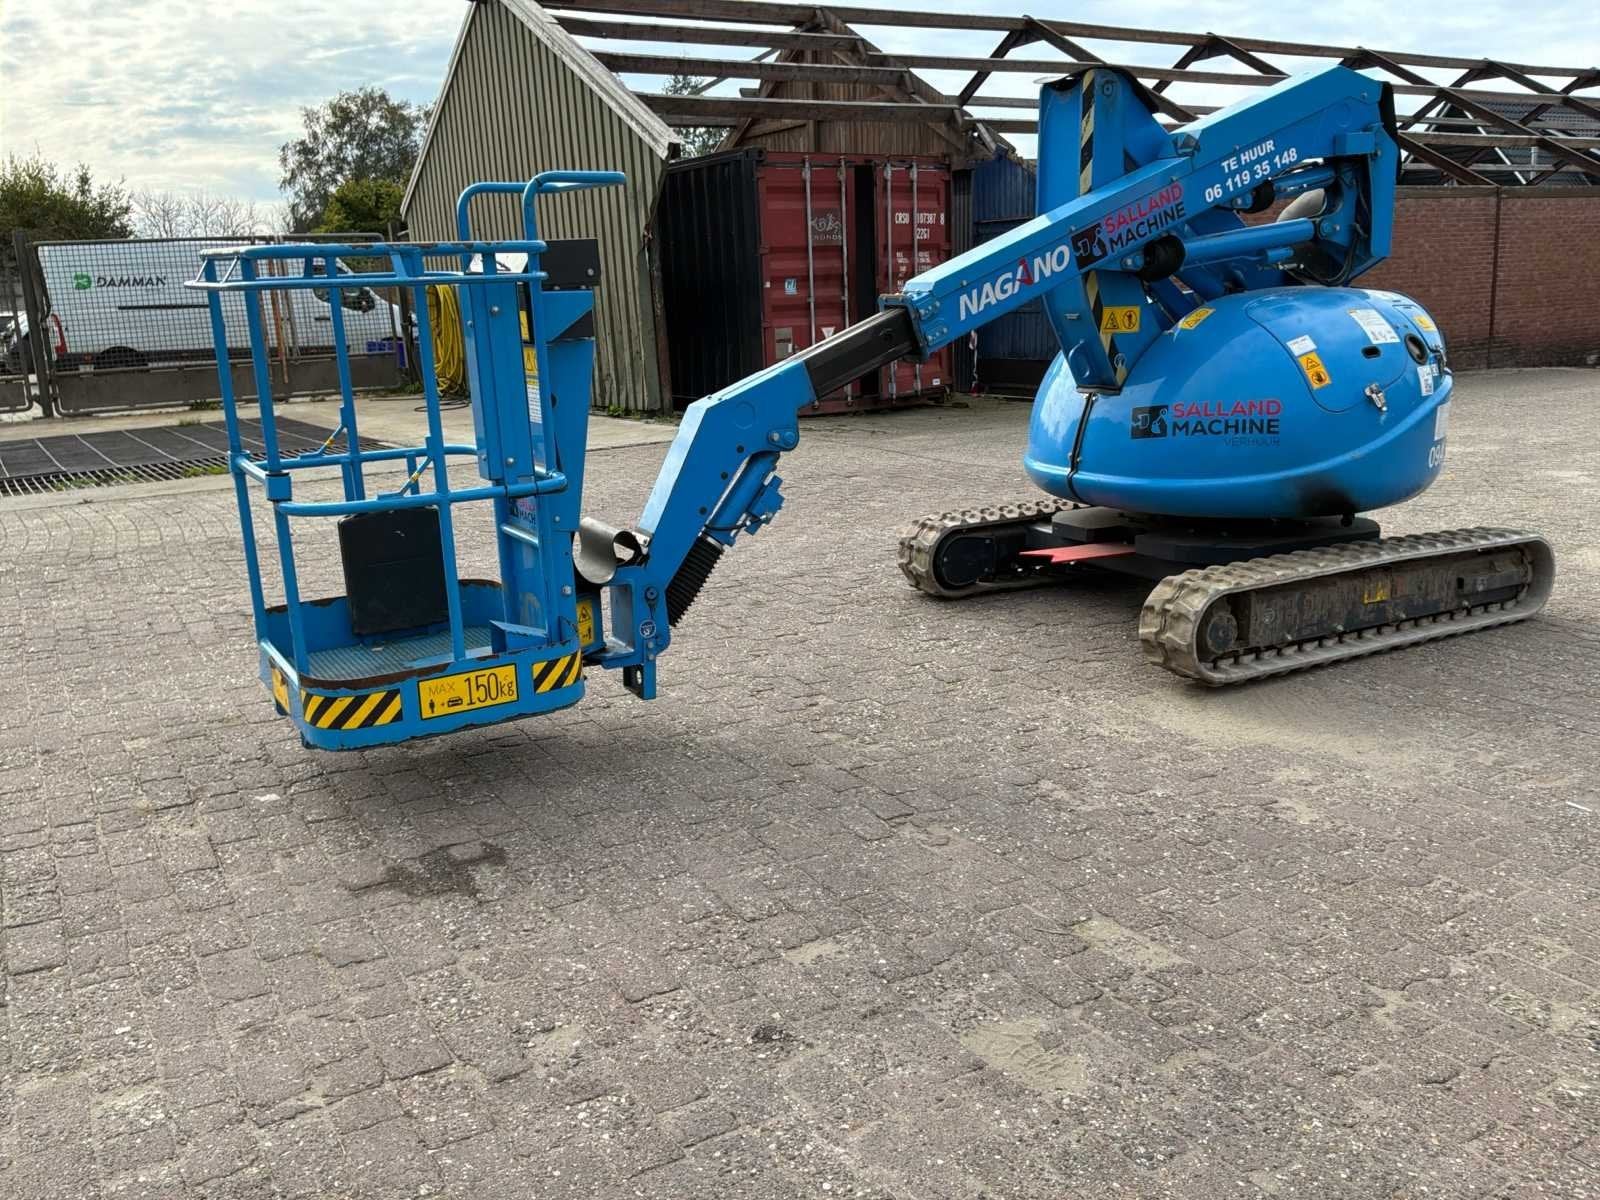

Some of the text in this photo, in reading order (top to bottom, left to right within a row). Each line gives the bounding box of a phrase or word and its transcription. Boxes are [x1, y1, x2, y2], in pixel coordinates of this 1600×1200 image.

[1221, 140, 1275, 173] TE HUUR
[1205, 147, 1298, 203] 06 119 35 148
[940, 213, 945, 225] 8
[1104, 182, 1184, 234] SALLAND
[1109, 202, 1185, 253] MACHINE
[96, 275, 167, 288] DAMMAN
[960, 244, 1070, 321] NAGANO
[1173, 400, 1281, 418] SALLAND
[1172, 418, 1280, 437] MACHINE
[428, 681, 456, 698] MAX
